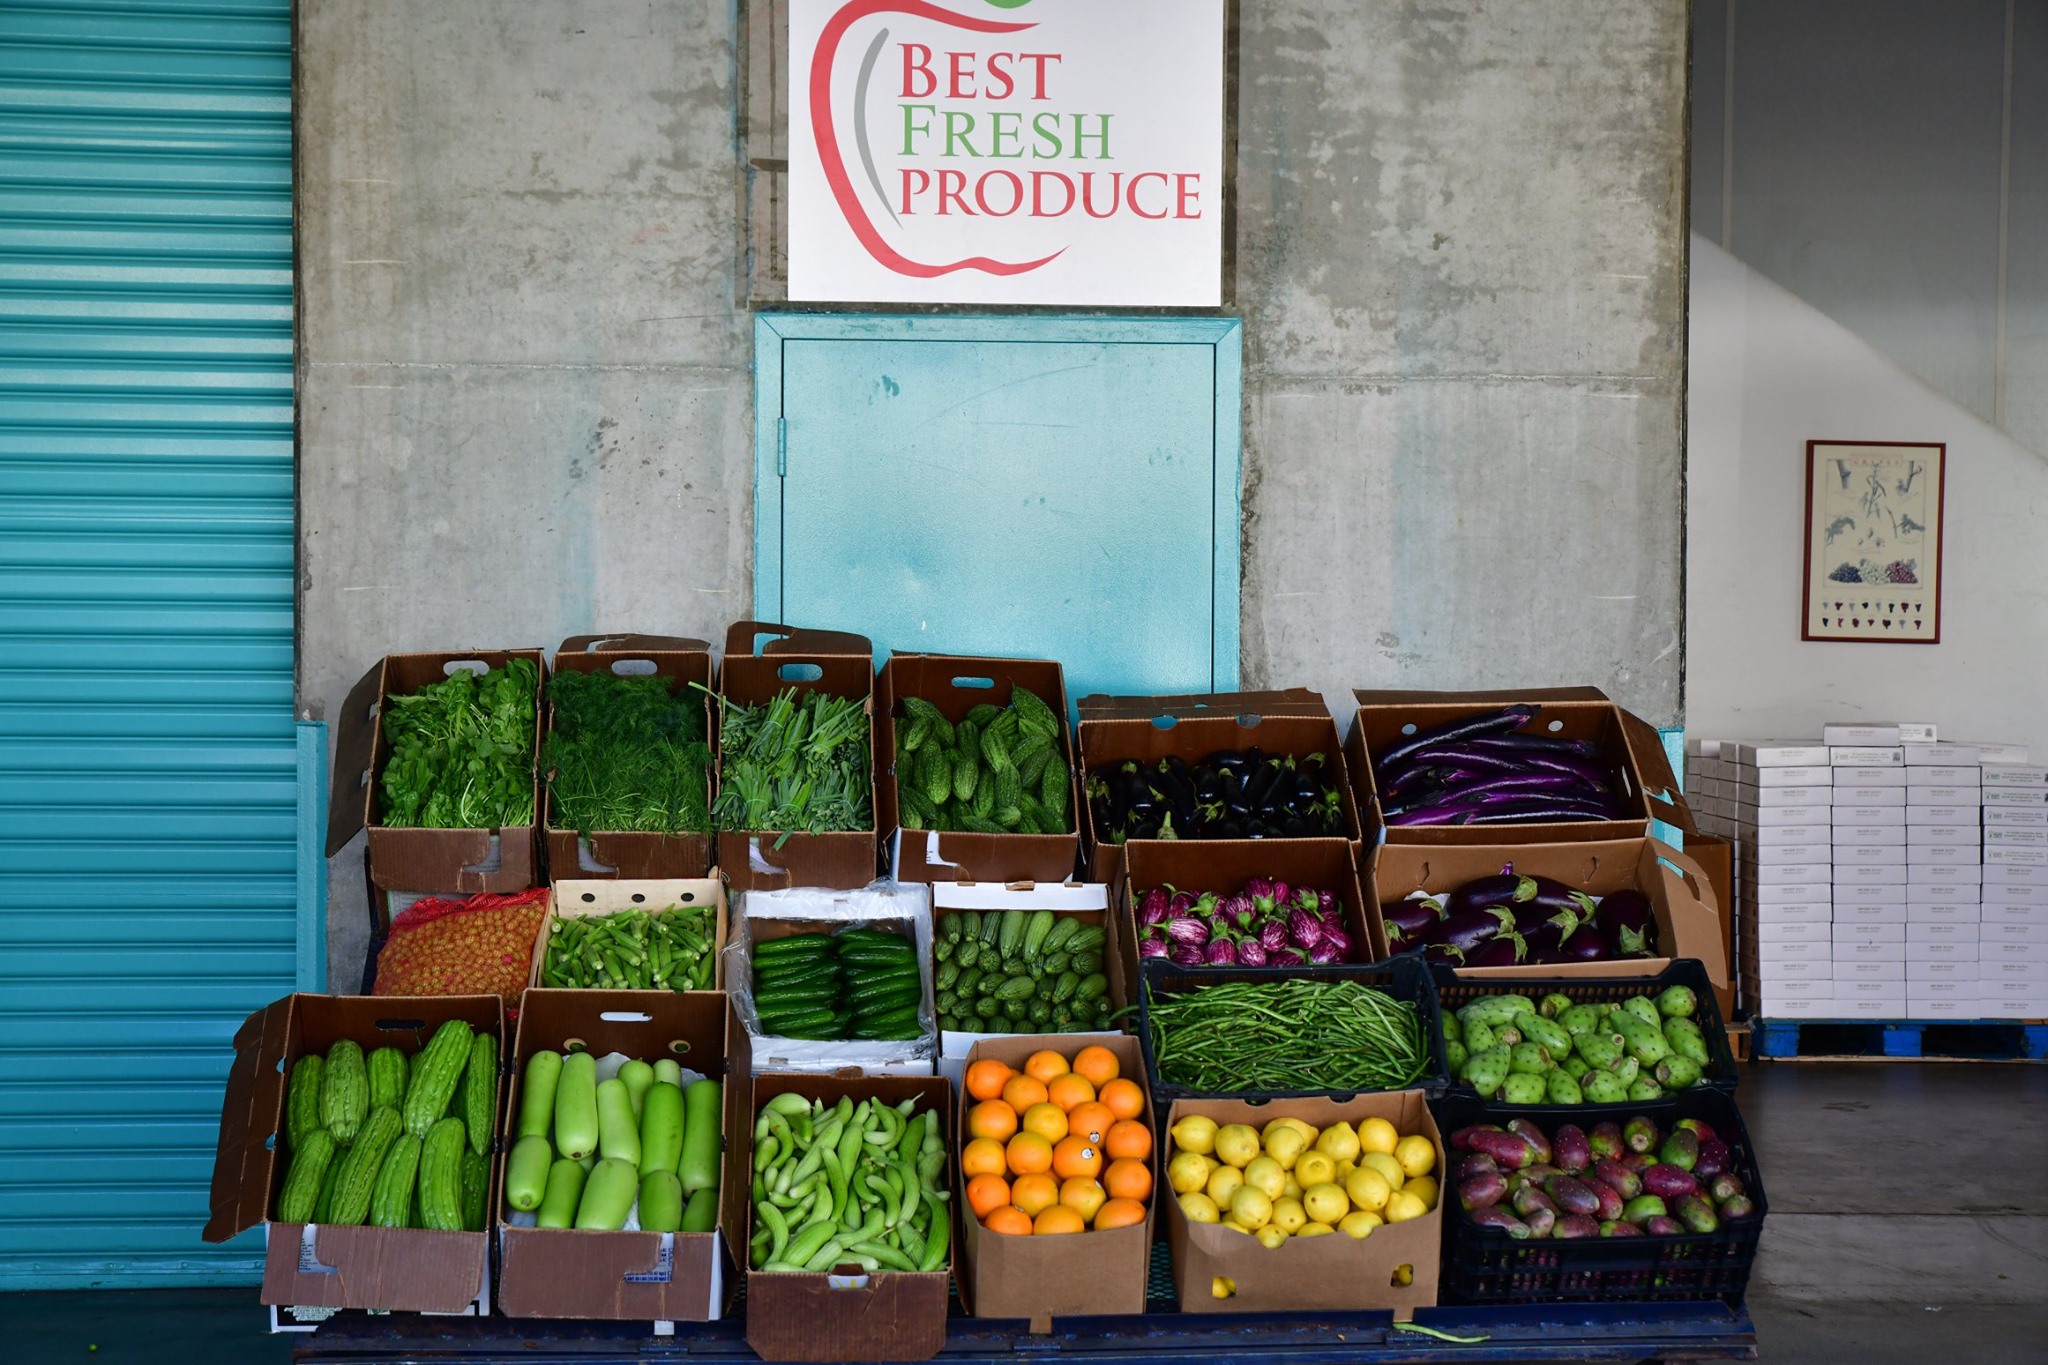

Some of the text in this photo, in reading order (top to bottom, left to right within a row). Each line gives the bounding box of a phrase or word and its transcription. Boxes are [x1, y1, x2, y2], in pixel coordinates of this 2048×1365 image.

[897, 43, 1062, 100] BEST
[897, 104, 1115, 159] FRESH
[897, 168, 1202, 219] PRODUCE
